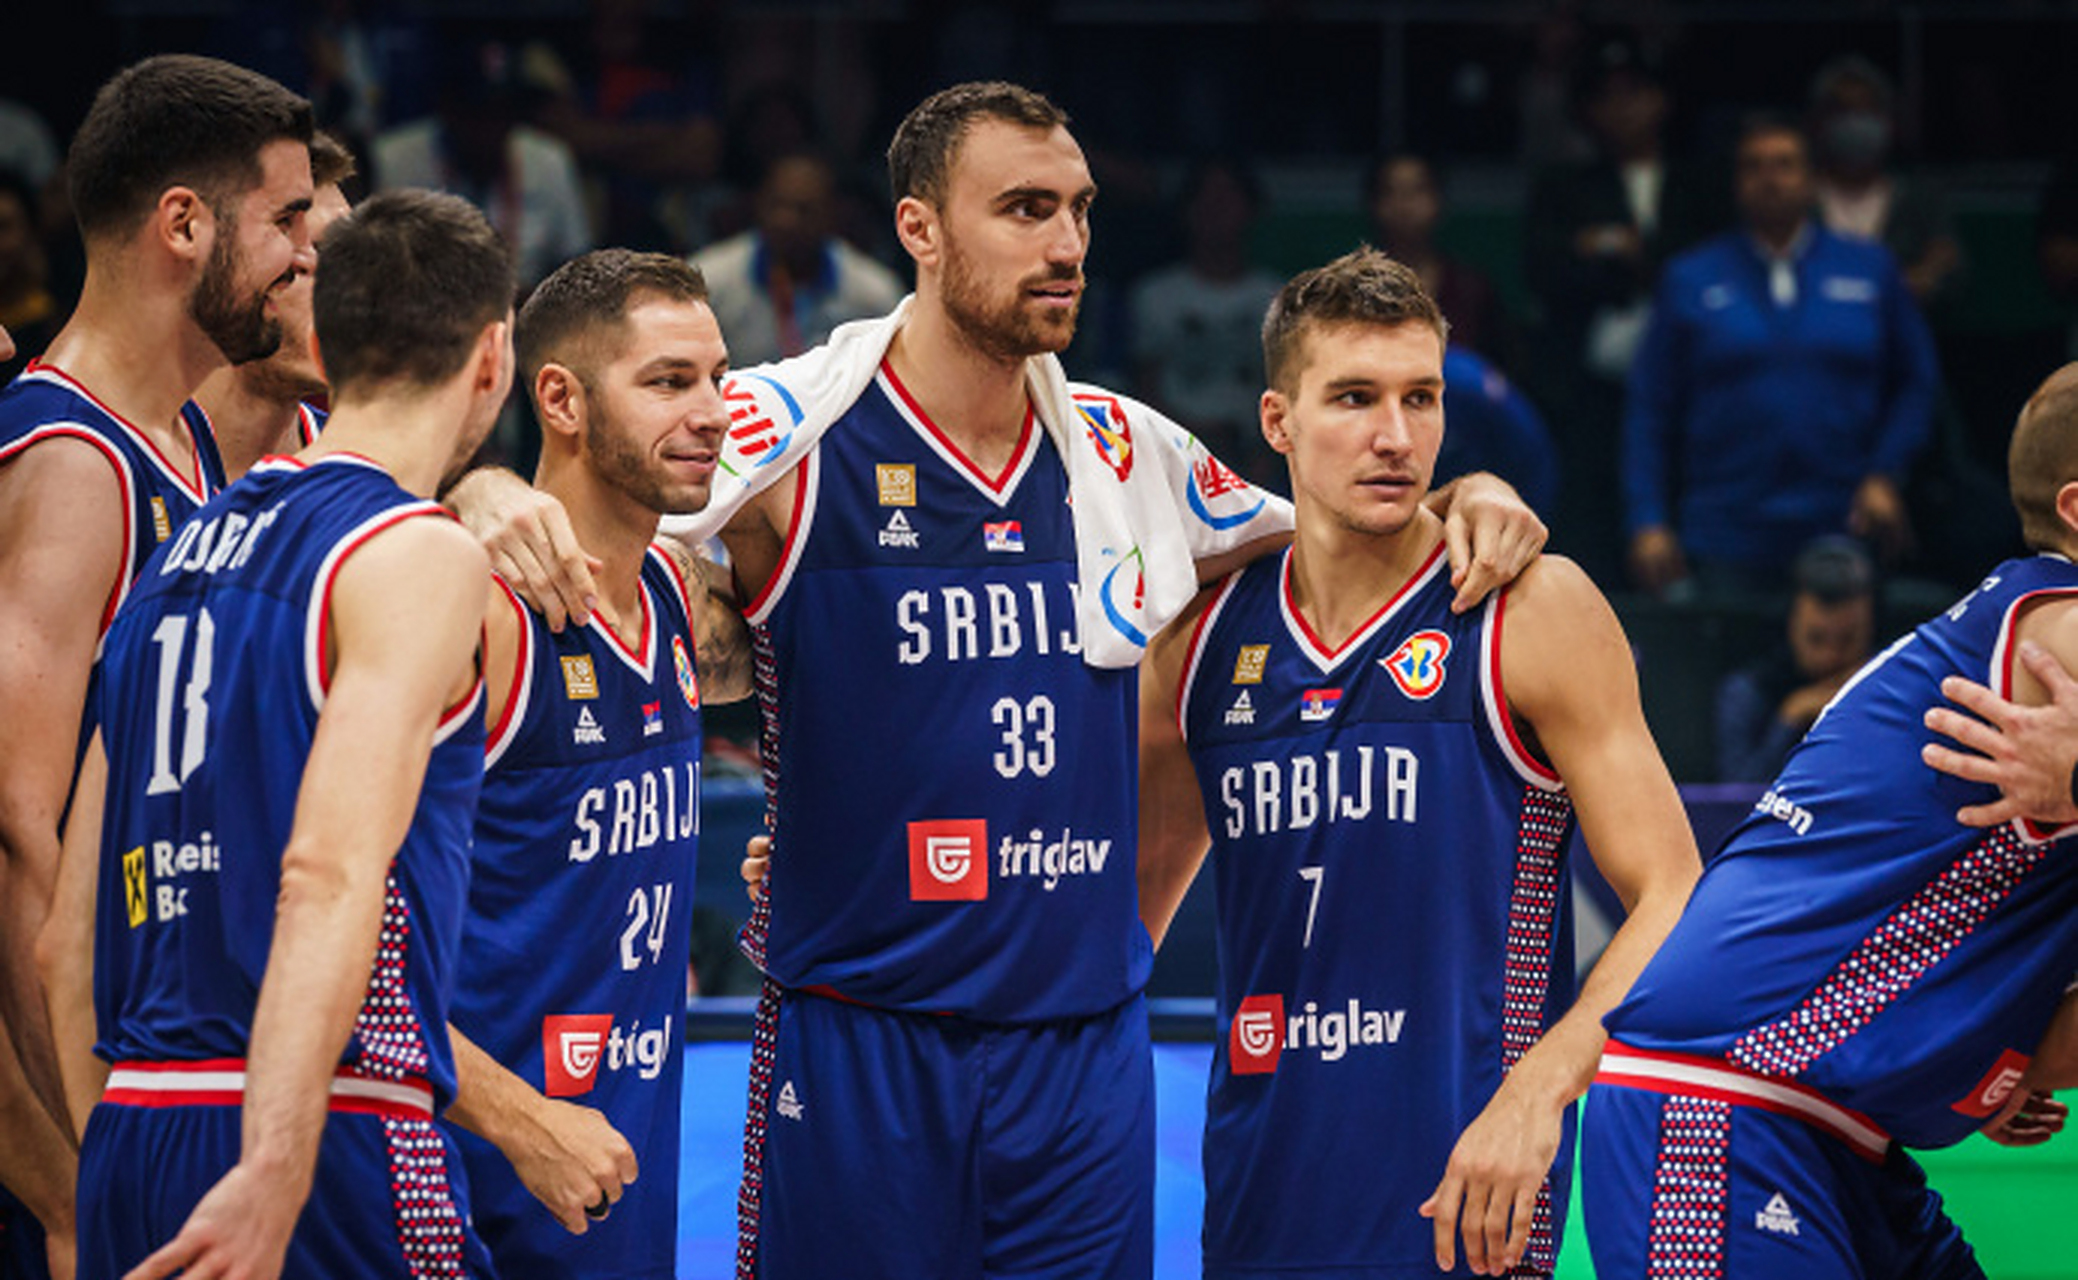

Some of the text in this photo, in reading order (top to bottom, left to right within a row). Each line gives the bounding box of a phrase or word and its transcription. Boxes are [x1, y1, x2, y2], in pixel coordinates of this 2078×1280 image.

[897, 581, 1082, 665] SRBIJ
[991, 695, 1056, 779] 33
[568, 761, 700, 863] SRBIJ
[1221, 746, 1420, 840] SRBIJA
[999, 827, 1112, 891] triglav
[619, 882, 673, 971] 24
[1298, 866, 1325, 948] 7
[1282, 999, 1406, 1061] riglav
